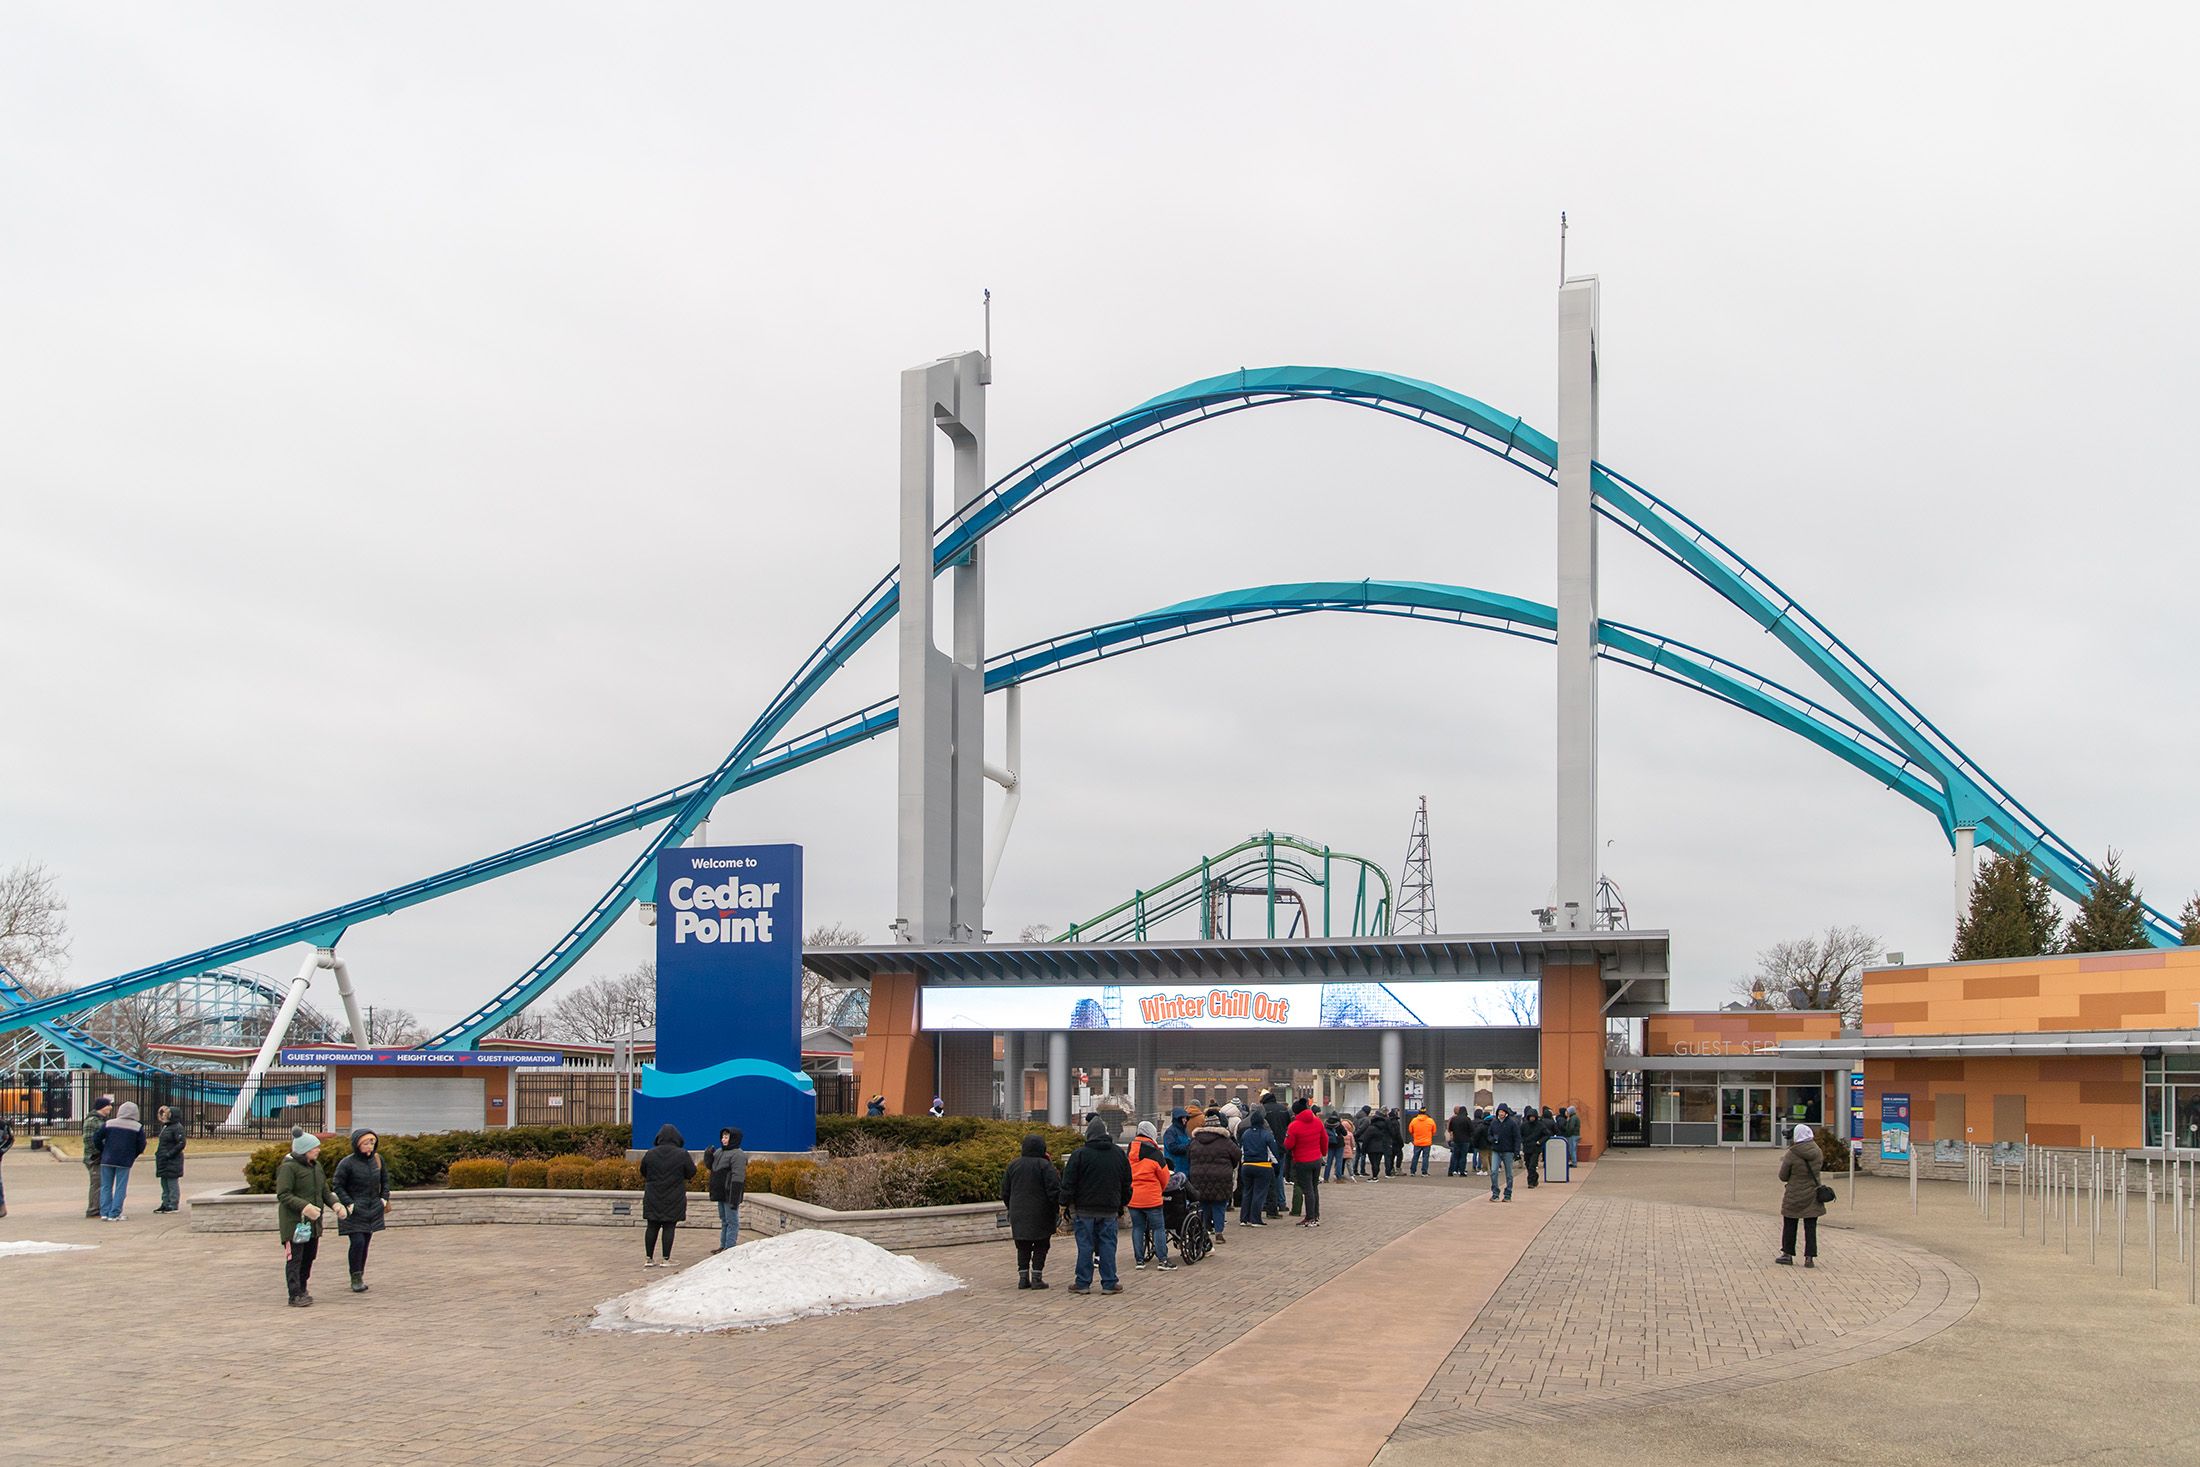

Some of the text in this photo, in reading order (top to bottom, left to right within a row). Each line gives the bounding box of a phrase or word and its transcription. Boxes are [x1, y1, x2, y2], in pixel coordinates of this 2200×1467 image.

[691, 857, 757, 869] Welcome to
[669, 876, 780, 910] Cedar
[675, 910, 773, 944] Point
[1140, 990, 1288, 1023] Winter Chill Out
[287, 1053, 314, 1061] GUEST
[315, 1053, 374, 1061] INFORMATION
[397, 1054, 427, 1062] HEIGHT
[503, 1055, 556, 1063] INFORMATION
[1674, 1040, 1779, 1056] GUEST SER
